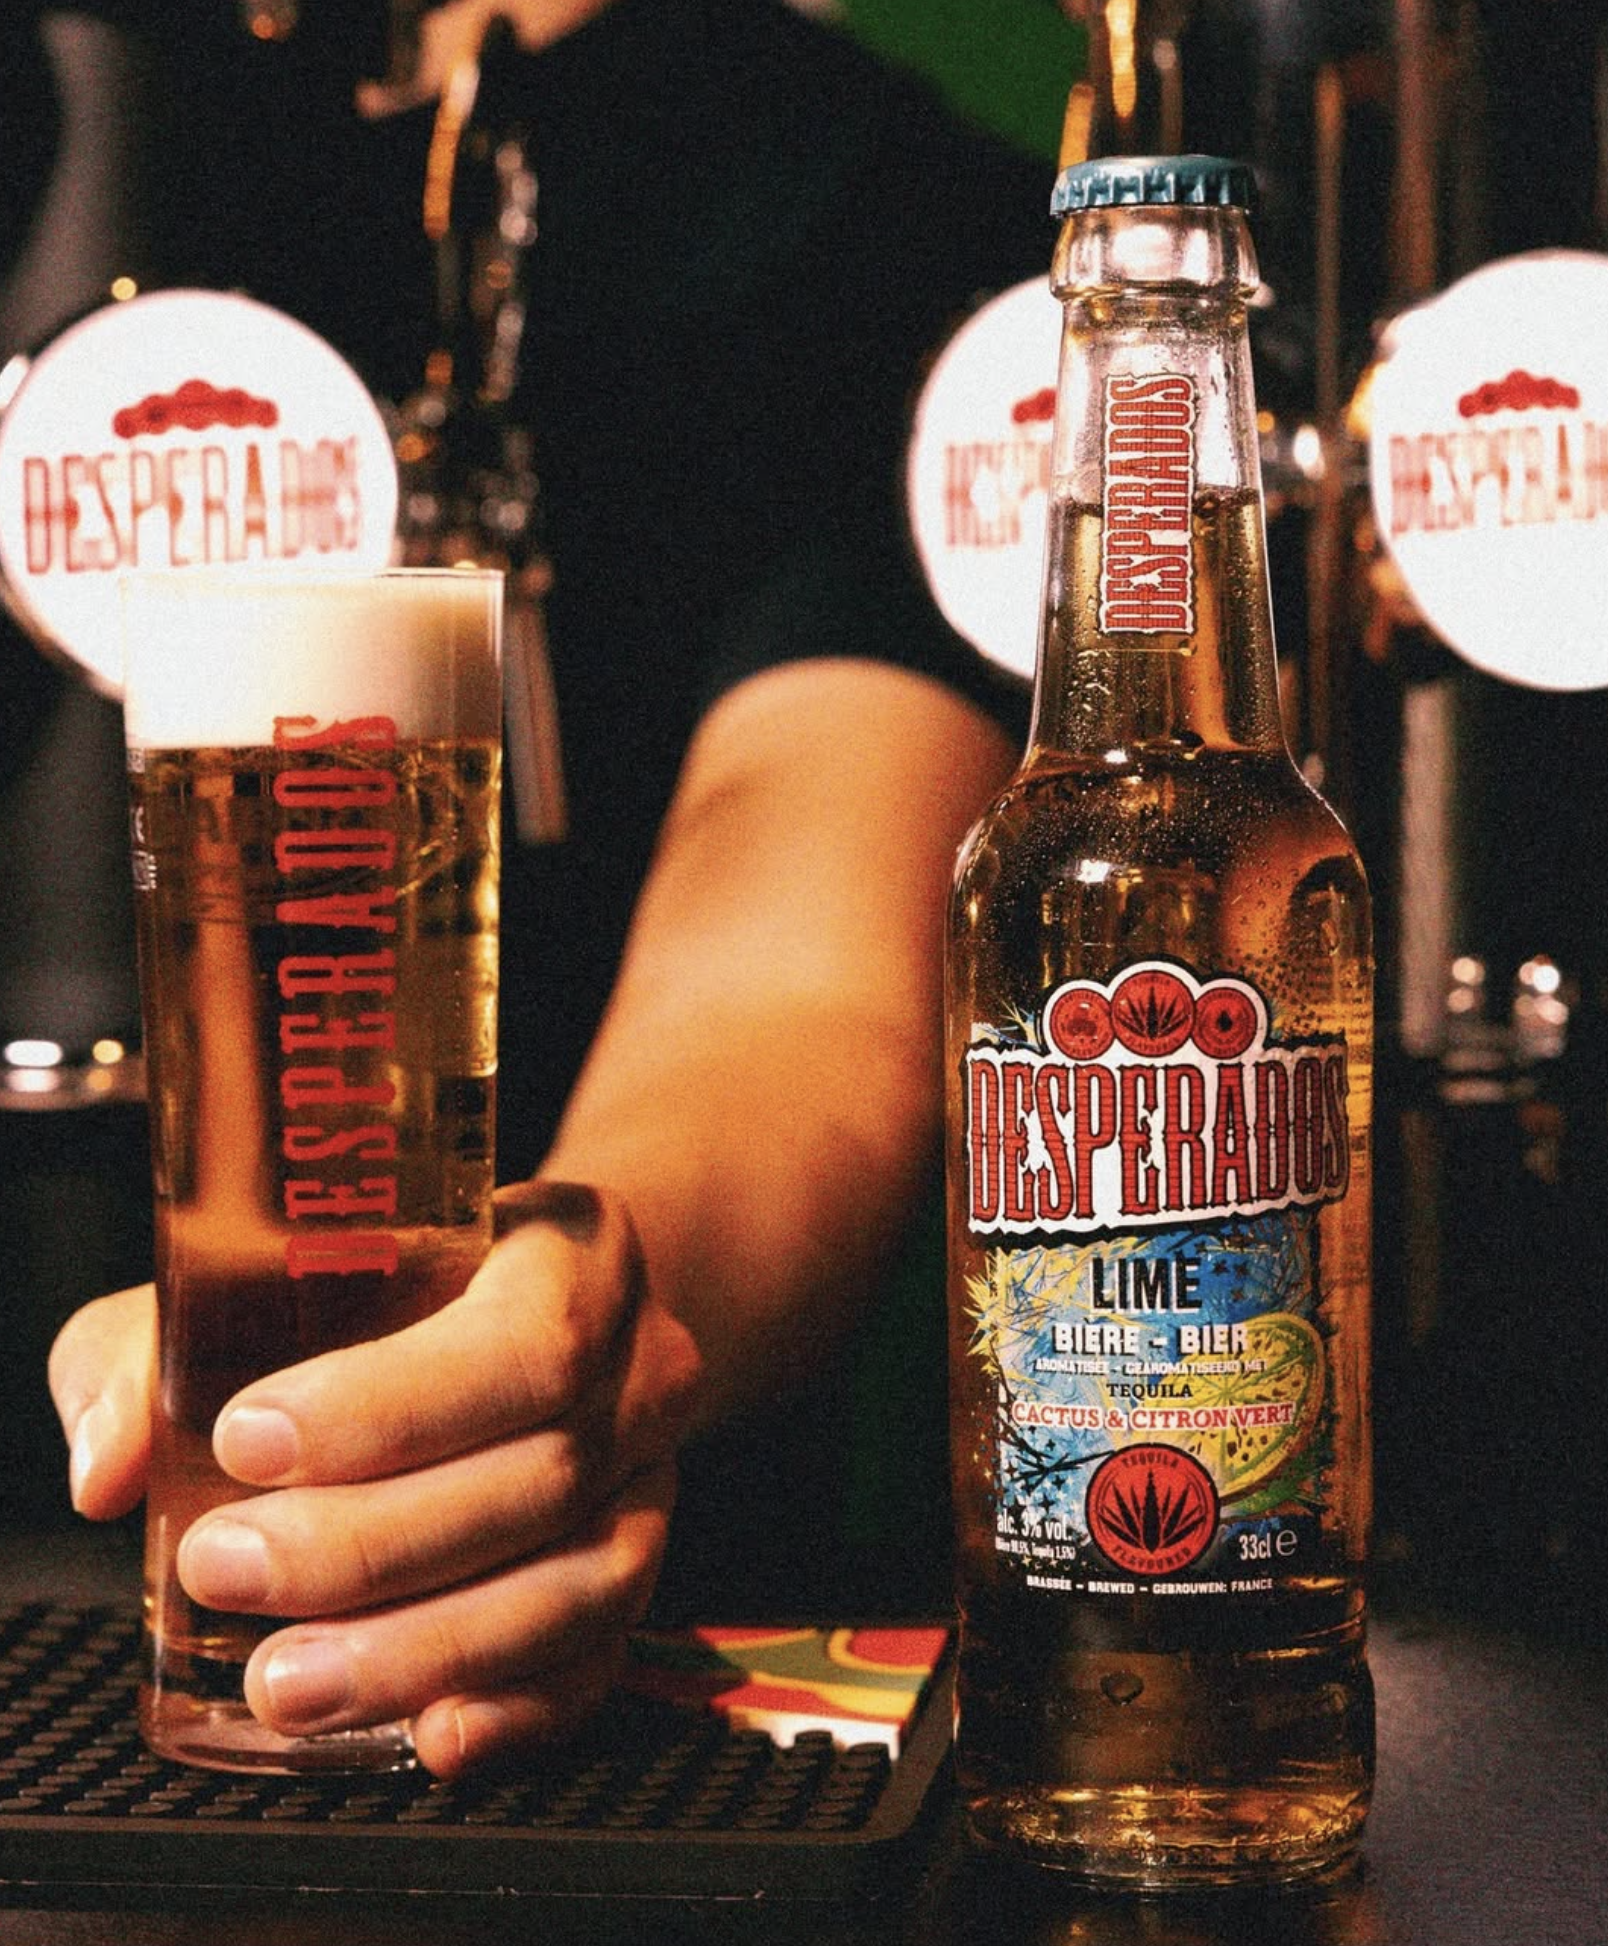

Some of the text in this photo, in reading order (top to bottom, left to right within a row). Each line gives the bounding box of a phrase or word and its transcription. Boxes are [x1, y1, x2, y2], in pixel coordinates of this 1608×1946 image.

[1103, 377, 1192, 632] DESPERADOS
[273, 716, 398, 1278] DESPERADOS
[967, 1055, 1348, 1222] DESPERADOS
[1090, 1257, 1203, 1312] LIME
[1177, 1324, 1250, 1355] BIER
[1106, 1383, 1193, 1399] TEQUILA
[1013, 1403, 1293, 1428] CACTUS & CITRON VERT
[1121, 1451, 1180, 1469] TEQUILA
[1045, 1517, 1073, 1542] vol.
[1239, 1534, 1272, 1560] 33cl
[1088, 1581, 1135, 1594] BREWED
[1153, 1582, 1227, 1594] GEBROUWEN:
[1231, 1578, 1273, 1593] FRANCE
